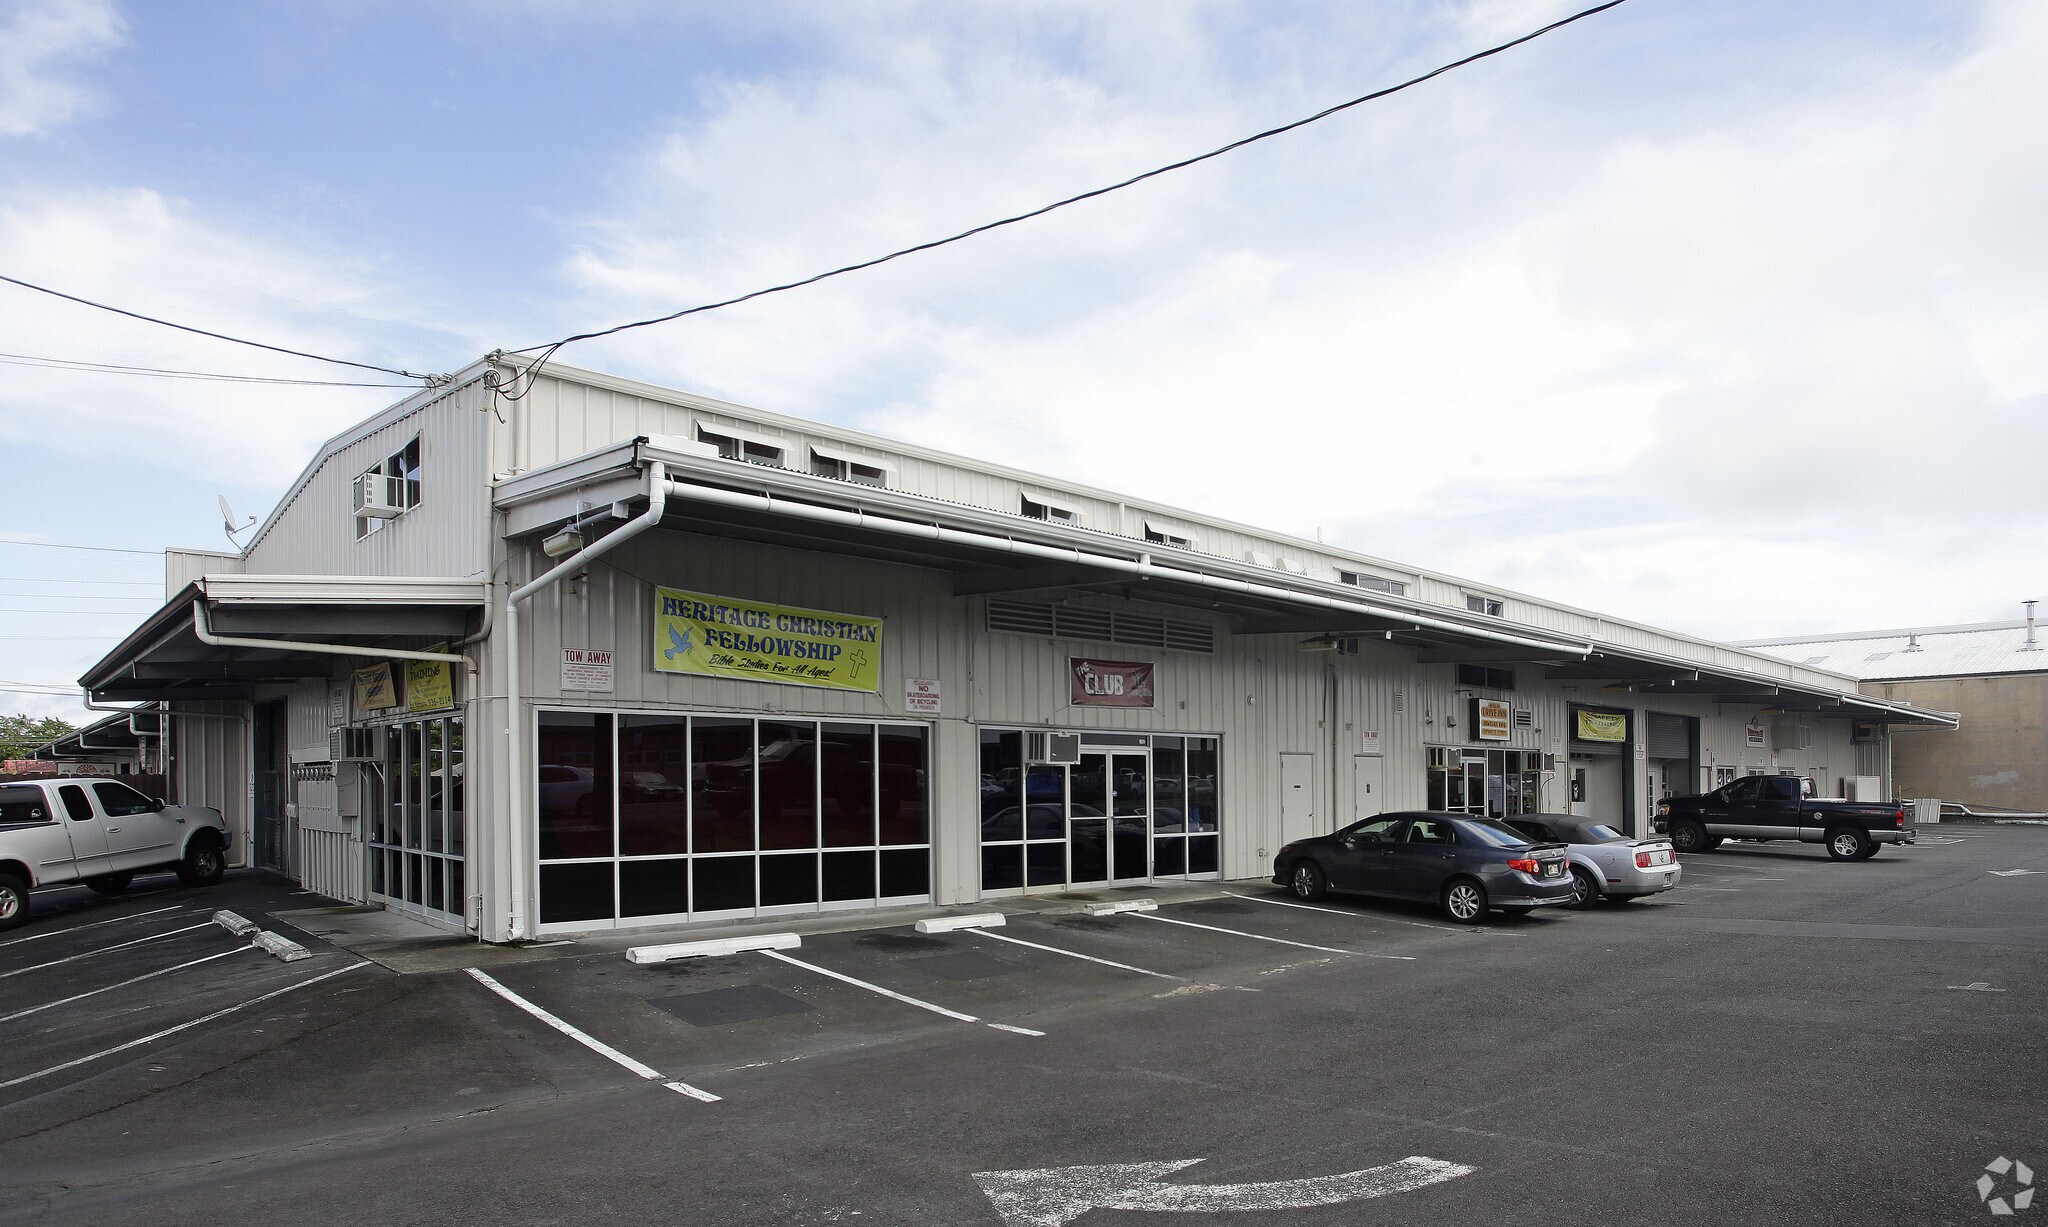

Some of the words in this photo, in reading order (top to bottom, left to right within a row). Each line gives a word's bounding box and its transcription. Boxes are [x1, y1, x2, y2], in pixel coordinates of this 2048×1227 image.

[662, 596, 771, 630] HERITAGE
[776, 613, 877, 643] CHRISTIAN
[565, 650, 583, 662] TOW
[587, 652, 611, 664] AWAY
[704, 628, 842, 662] FELLOWSHIP
[709, 653, 734, 667] Bible
[737, 657, 769, 670] Studies
[773, 661, 789, 672] For
[790, 664, 807, 675] All
[806, 667, 836, 679] Ages!
[1076, 661, 1090, 676] THE
[1084, 673, 1124, 696] CLUB
